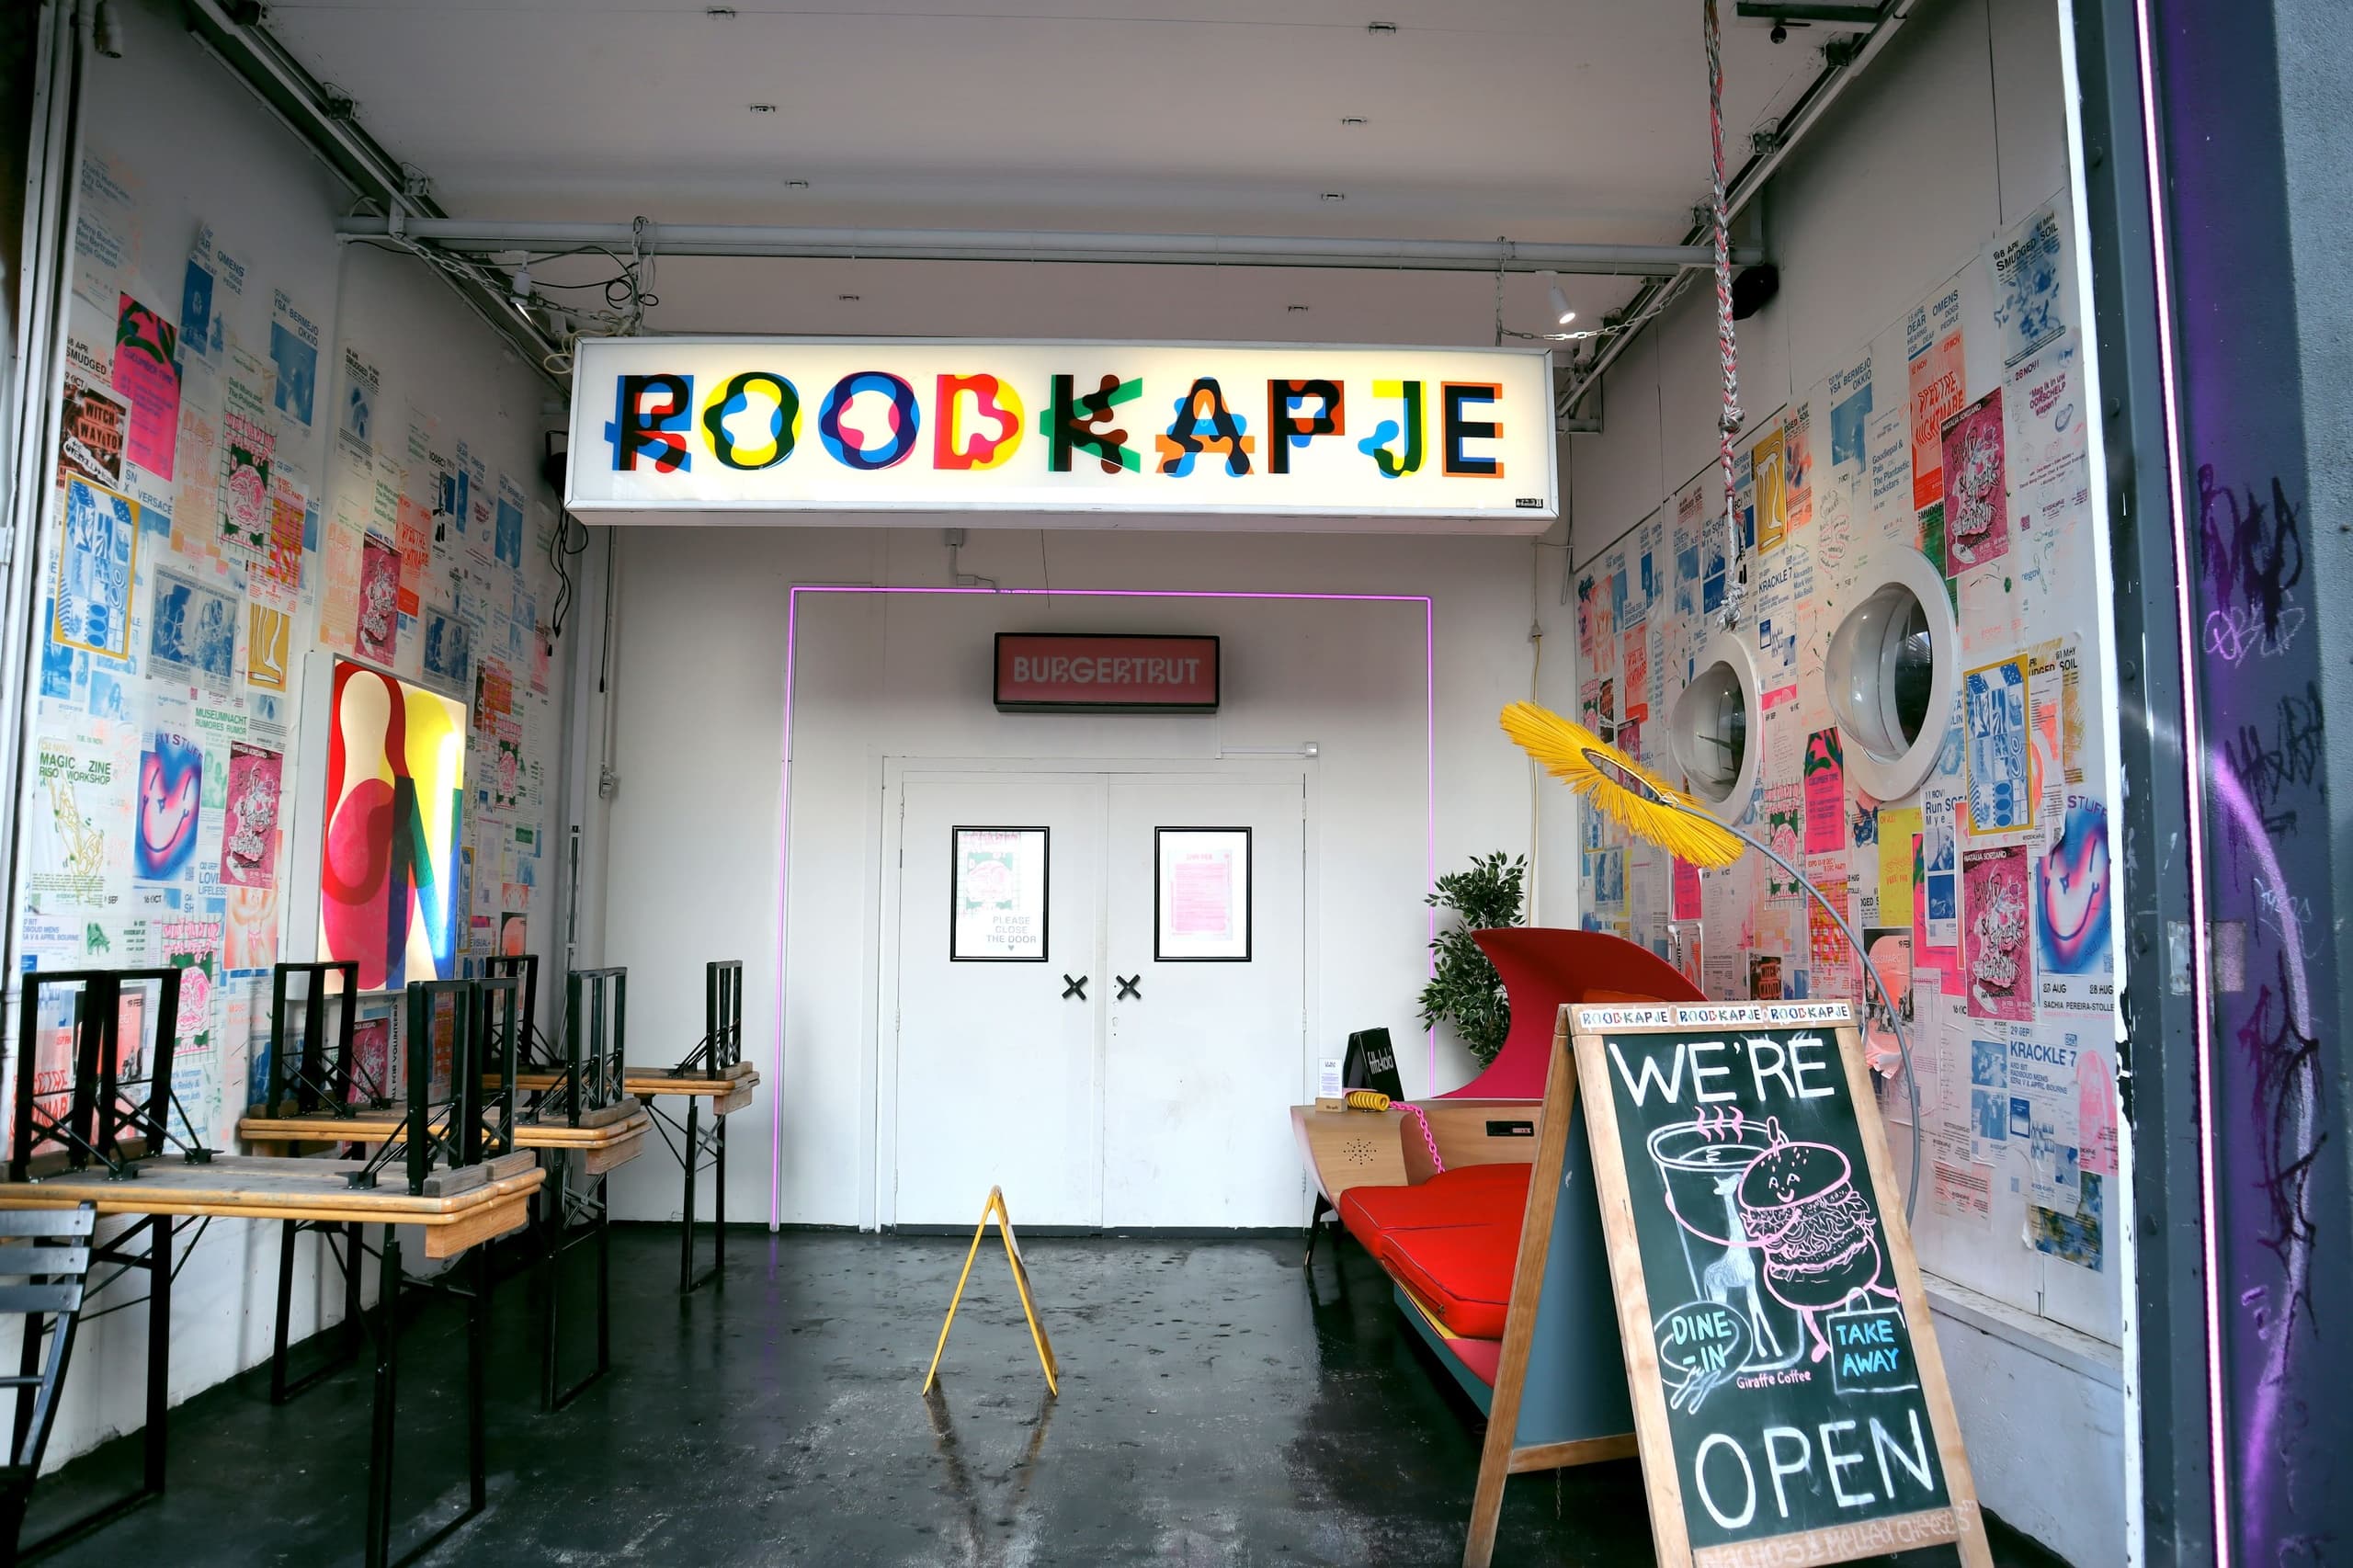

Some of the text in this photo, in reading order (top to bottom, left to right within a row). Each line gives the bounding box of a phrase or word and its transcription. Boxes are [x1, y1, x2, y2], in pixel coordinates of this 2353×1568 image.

[1996, 223, 2059, 272] SMUDGED SOIL
[217, 250, 244, 278] OMENS
[273, 297, 319, 336] YSA BERMEJO
[1907, 290, 1959, 336] DEAR OMENS
[299, 326, 318, 347] OKKIO
[66, 346, 107, 375] SMUDGED
[1830, 358, 1871, 397] YSA BERMEJO
[1852, 369, 1871, 391] OKKIO
[1917, 370, 1959, 414] SPECTRE
[85, 403, 116, 425] WITCH
[605, 370, 1505, 478] ROODKAPJE
[125, 469, 137, 483] SN
[1873, 474, 1884, 486] The
[123, 483, 173, 516] X VERSACE
[1873, 480, 1900, 498] Rockstars
[1758, 569, 1788, 595] KRACKLE
[2063, 647, 2077, 659] MAY
[1014, 656, 1199, 685] BURGERTRUT
[2060, 658, 2078, 672] SOIL
[195, 707, 247, 725] MUSEUMNACHT
[194, 719, 247, 736] RUMORES RUMOR
[40, 752, 111, 776] MAGIC ZINE
[39, 767, 111, 786] RISO WORKSHOP
[1926, 801, 1942, 816] Run
[1963, 852, 1983, 862] NATALIA
[199, 871, 221, 884] LOV
[108, 895, 119, 904] SEP
[150, 894, 162, 903] OCT
[199, 886, 227, 897] LIFELESS
[993, 916, 1030, 925] PLEASE
[995, 926, 1028, 934] CLOSE
[986, 935, 1036, 943] THE DOOR
[2052, 983, 2067, 994] AUG
[2098, 985, 2114, 994] AUG
[1582, 1005, 1847, 1027] ROODKAPJE ROODKAPJE ROODKAPJE
[2010, 1040, 2077, 1068] KRACKLE 7
[1609, 1037, 1835, 1108] WE'RE
[1672, 1311, 1733, 1346] DINE
[1836, 1320, 1894, 1347] TAKE
[1842, 1347, 1900, 1378] AWAY
[1736, 1369, 1813, 1391] Giraffe Coffee
[1695, 1408, 1933, 1529] OPEN
